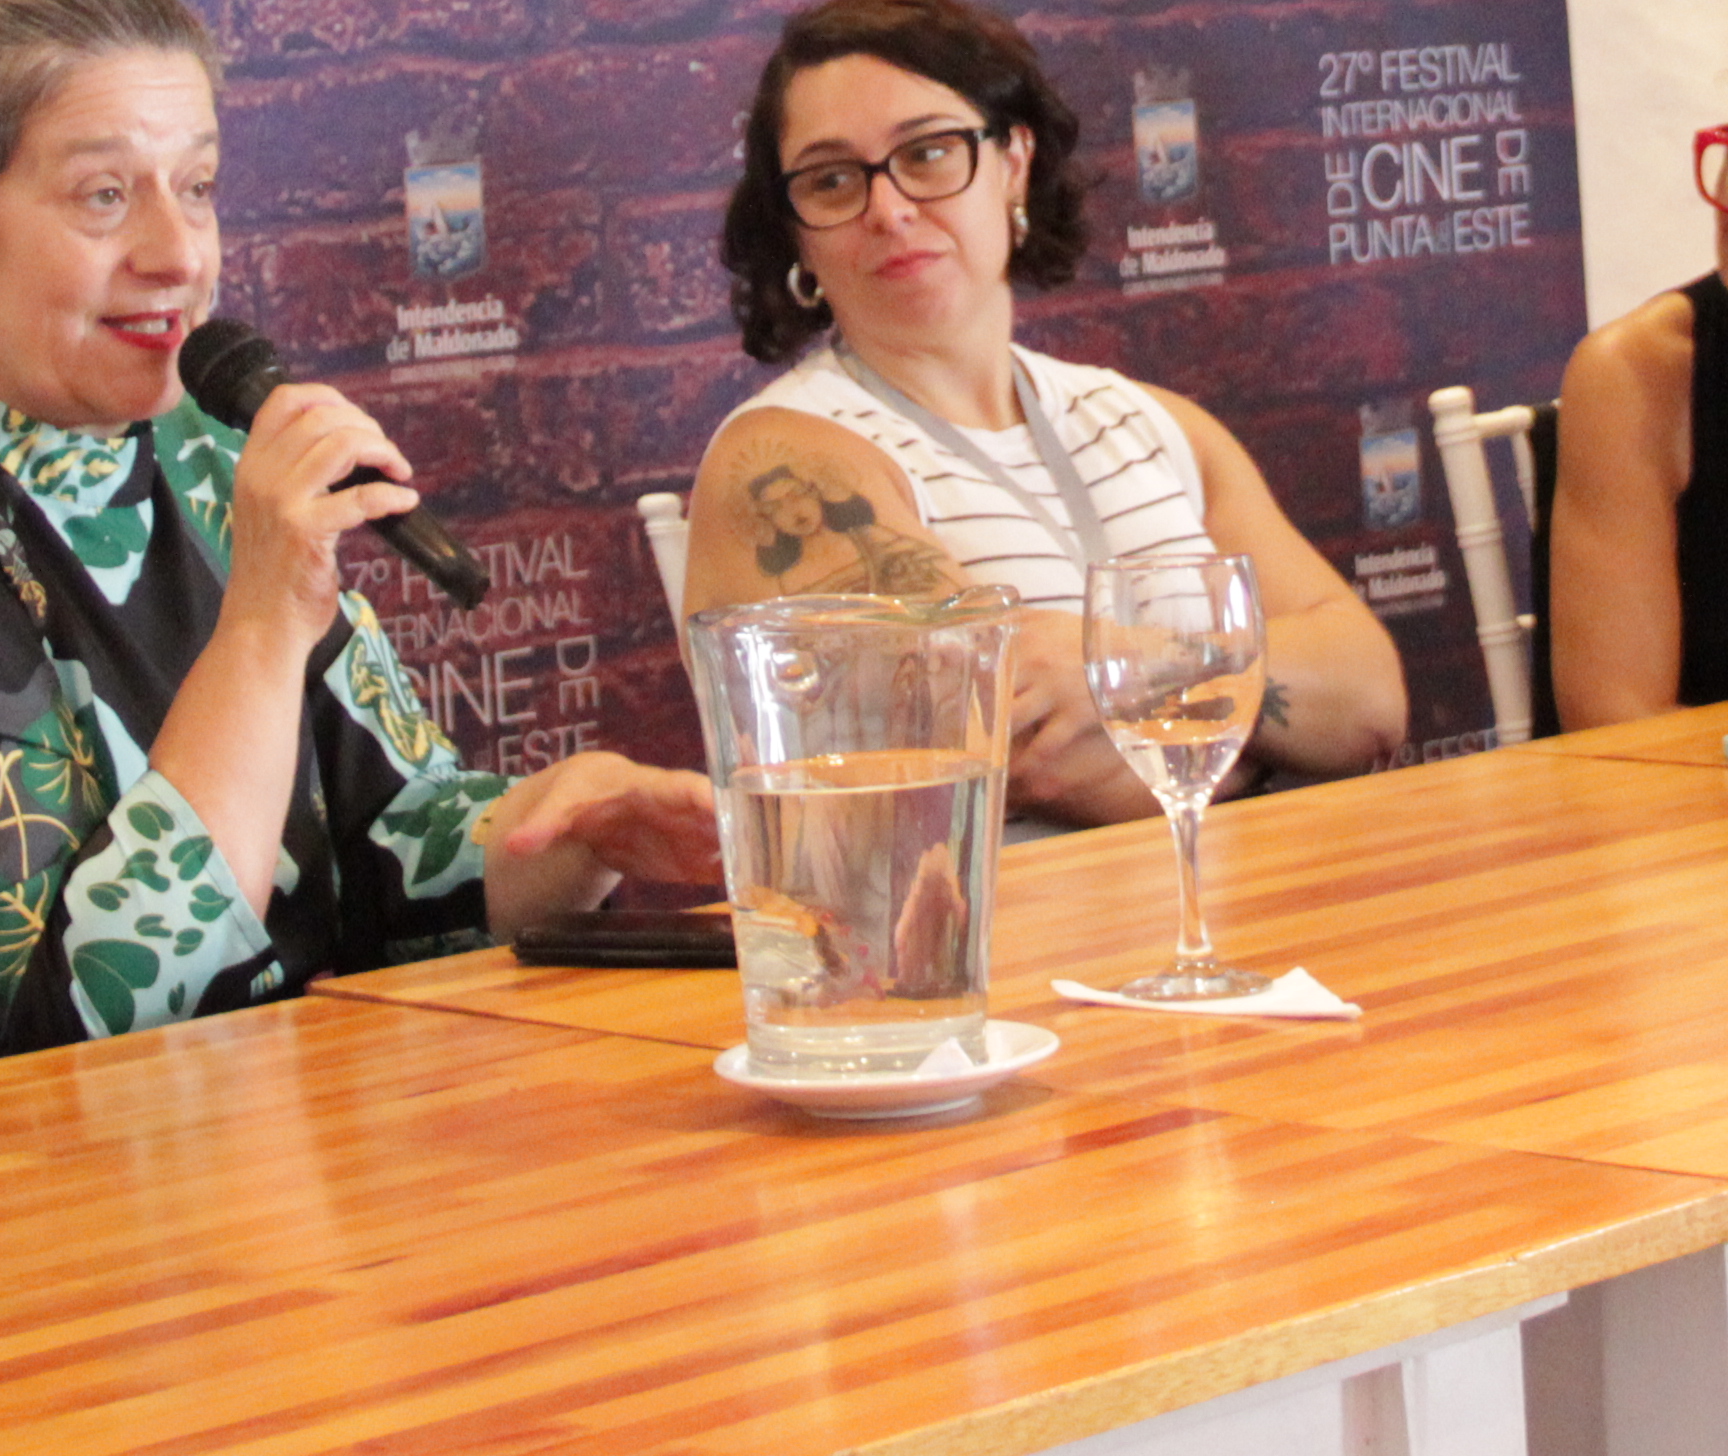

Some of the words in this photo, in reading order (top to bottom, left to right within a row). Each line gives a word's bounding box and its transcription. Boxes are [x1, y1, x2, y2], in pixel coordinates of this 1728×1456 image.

[1380, 43, 1521, 92] FESTIVAL
[1321, 90, 1522, 138] INTERNACIONAL
[1325, 148, 1358, 218] DE
[1362, 134, 1485, 211] CINE
[1495, 128, 1531, 196] DE
[1328, 214, 1434, 265] PUNTA
[1453, 202, 1534, 253] ESTE
[397, 293, 503, 331] Intendencia
[415, 323, 520, 358] Maldonado
[402, 532, 590, 604] FTIVAL
[400, 646, 536, 732] INE
[556, 635, 599, 715] DE
